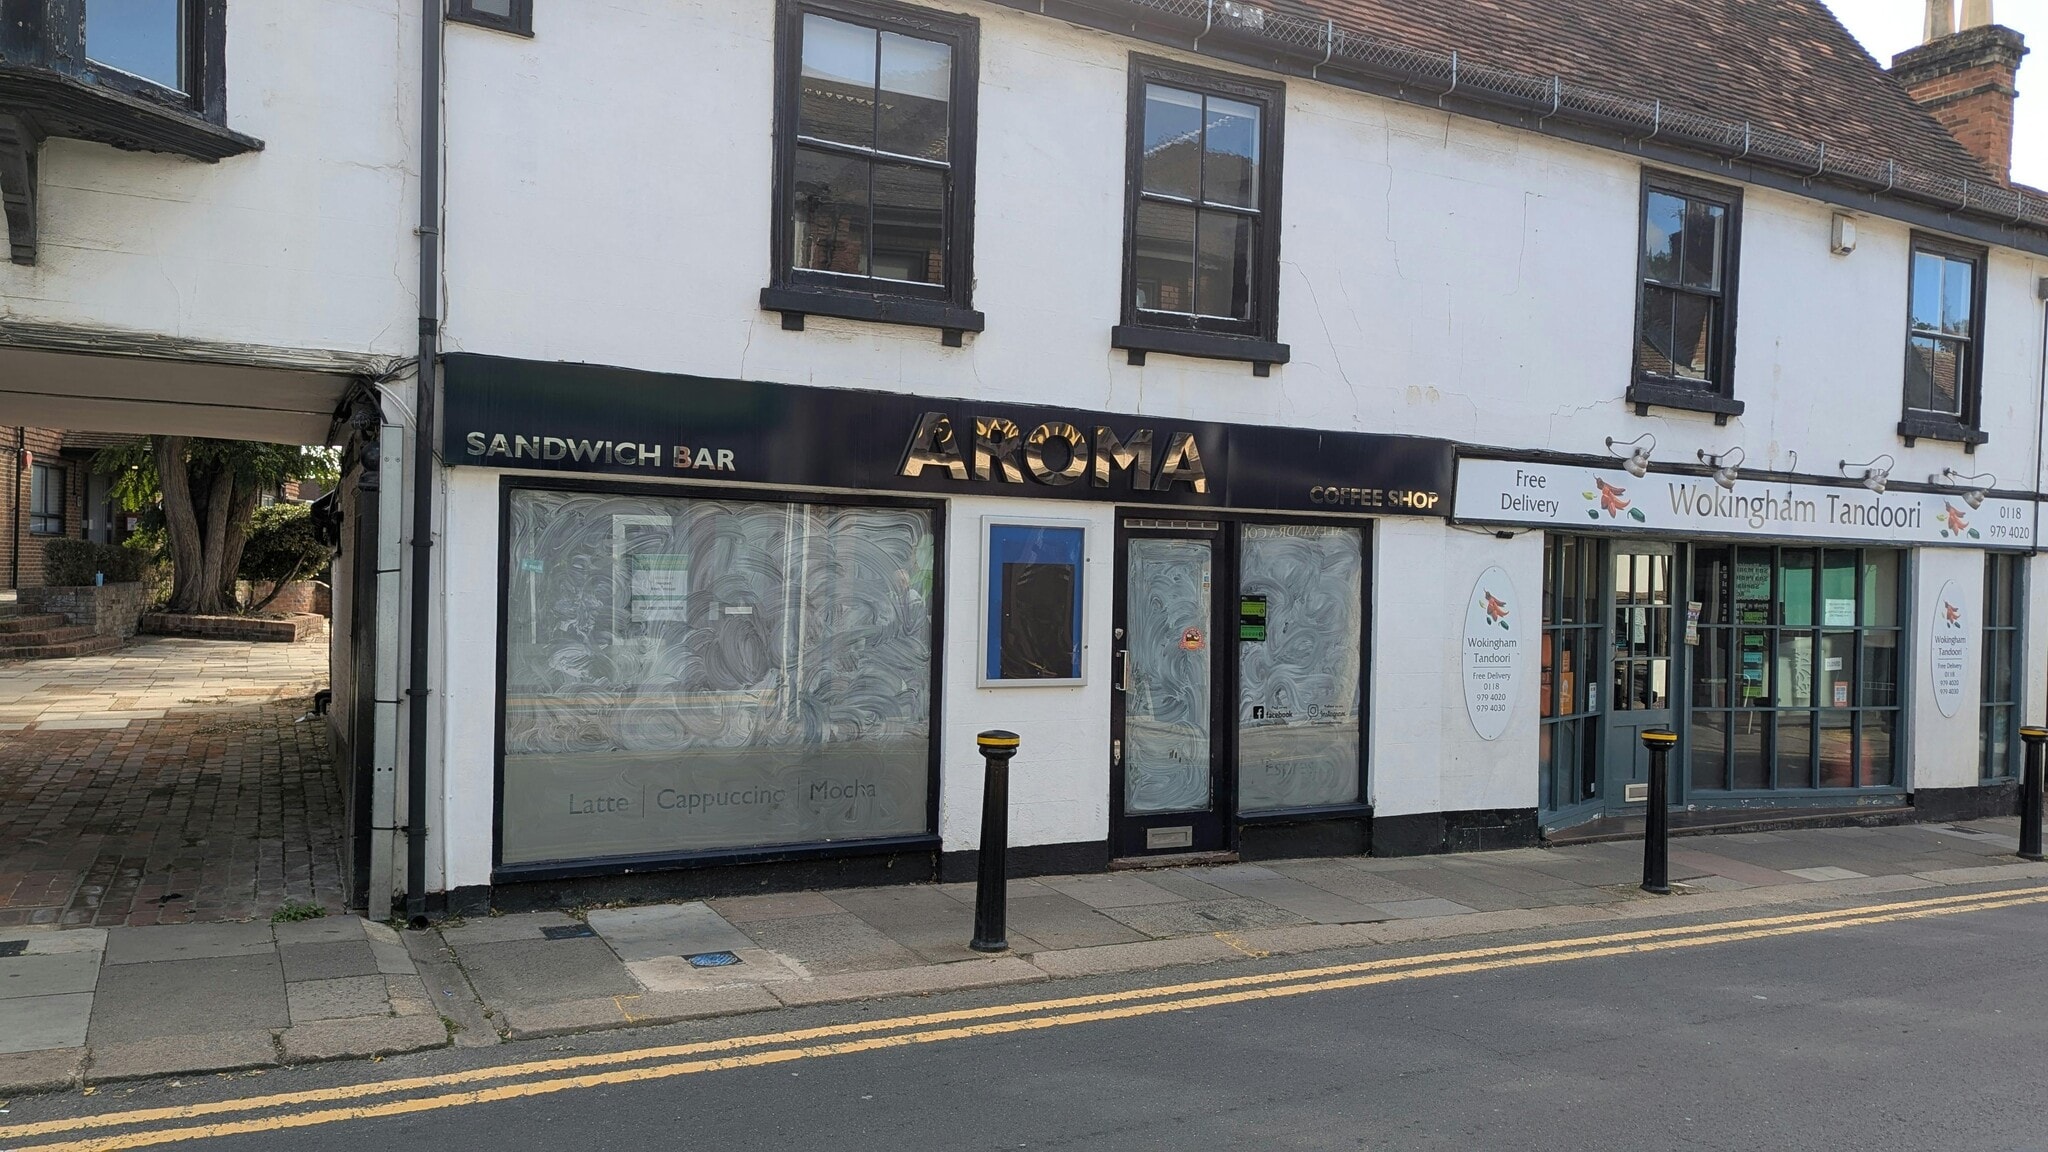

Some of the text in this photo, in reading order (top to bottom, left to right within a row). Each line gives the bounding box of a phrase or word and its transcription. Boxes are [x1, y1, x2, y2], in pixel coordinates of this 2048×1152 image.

[466, 431, 736, 471] SANDWICH BAR
[894, 411, 1211, 494] AROMA
[1516, 469, 1546, 488] Free
[1309, 485, 1439, 509] COFFEE SHOP
[1501, 493, 1559, 518] Delivery
[1668, 482, 1921, 529] Wokingham Tandoori
[1999, 506, 2022, 519] 0118
[1990, 525, 2030, 539] 979 4020
[1467, 637, 1517, 650] Wokingham
[1935, 635, 1966, 645] Wokingham
[1474, 652, 1511, 663] Tandoori
[1938, 647, 1963, 656] Tandoori
[1472, 672, 1511, 681] Free Delivery
[1476, 693, 1506, 701] 979 4020
[1476, 704, 1506, 712] 979 4030
[1266, 711, 1293, 719] facebook
[569, 779, 876, 815] Latte Cappuccino Mocha
